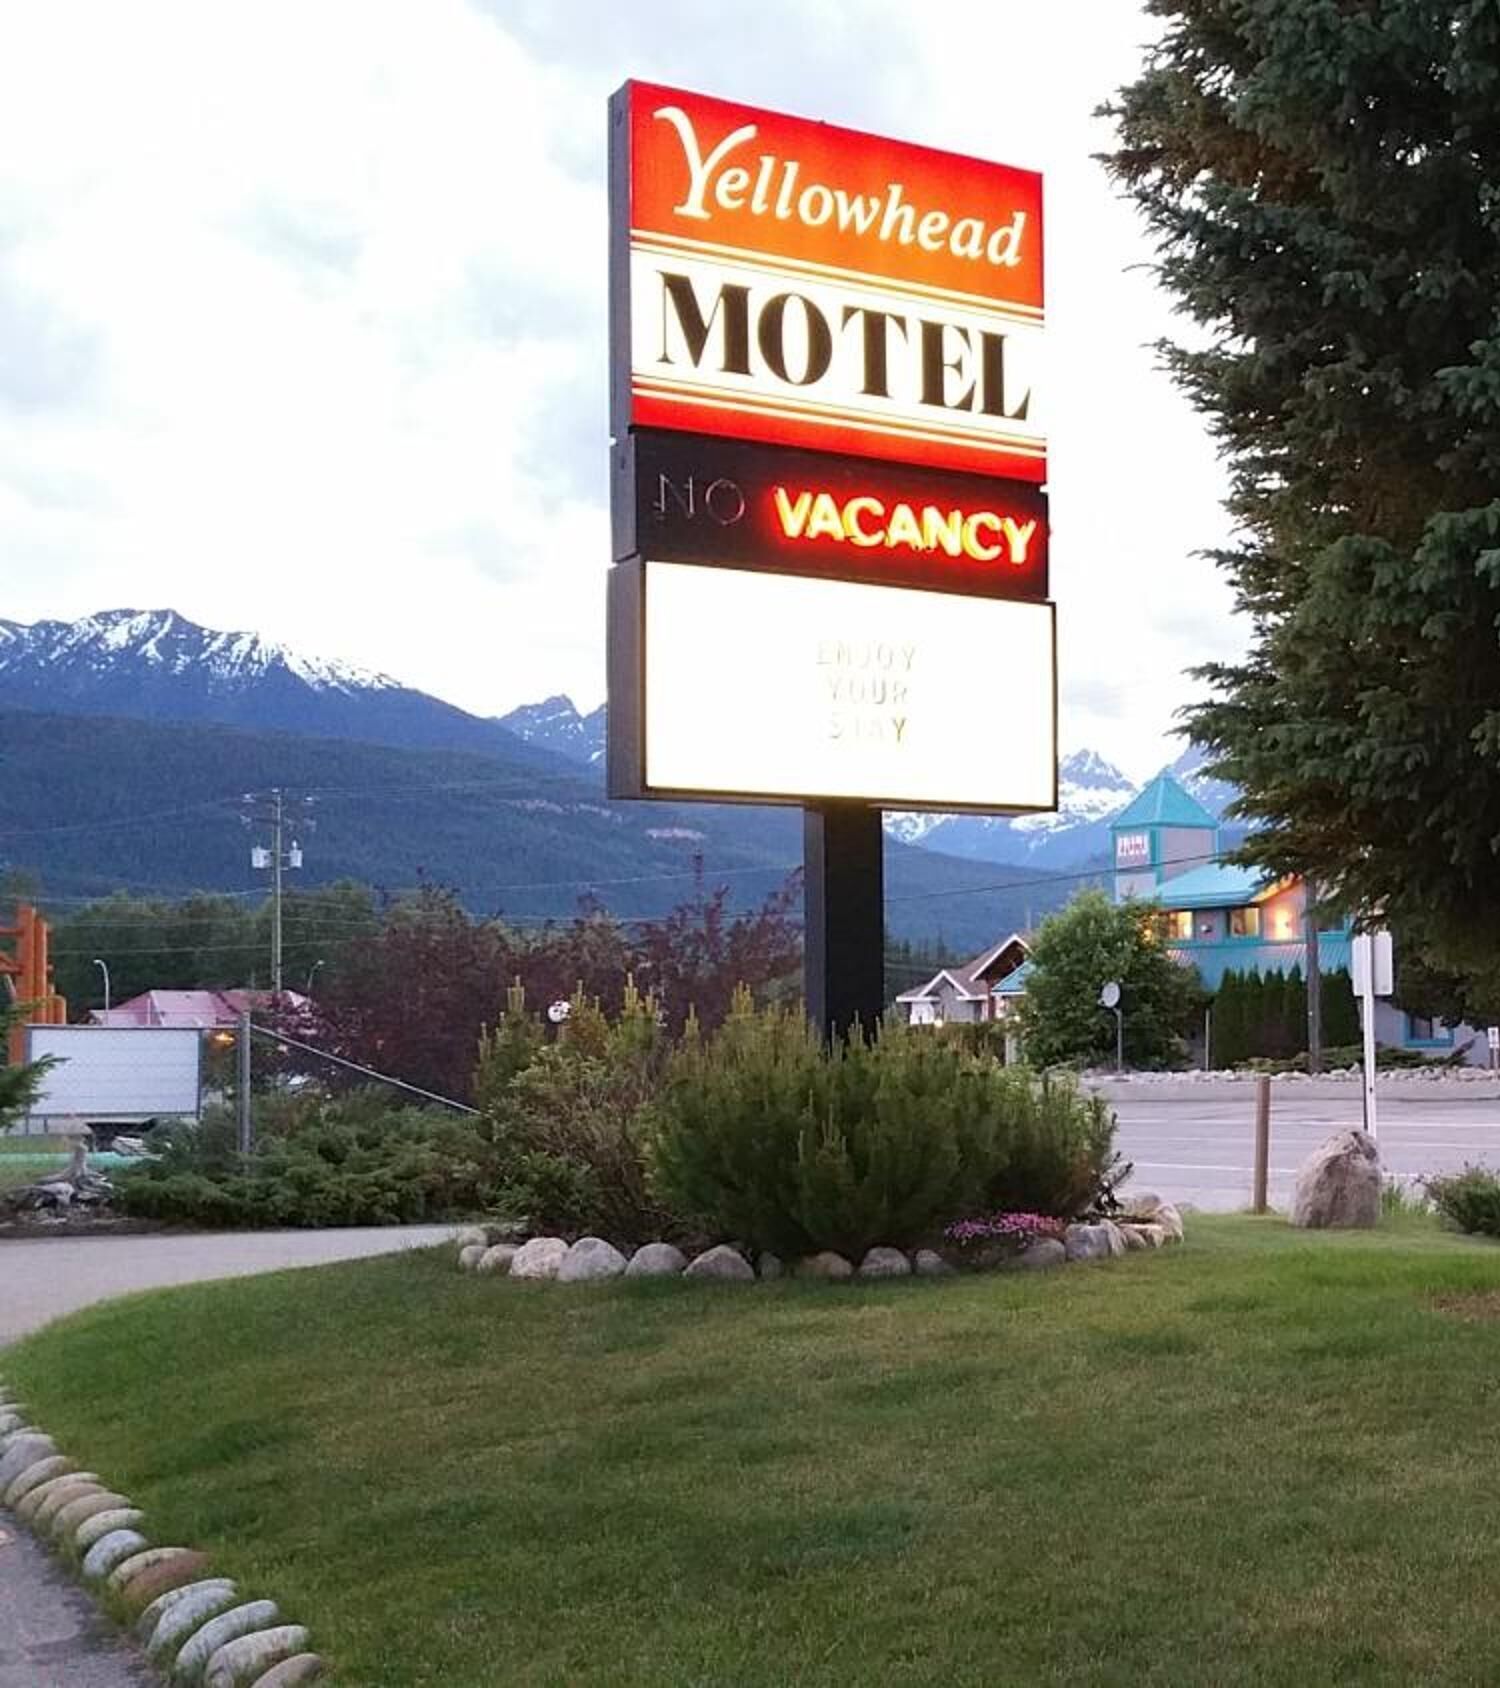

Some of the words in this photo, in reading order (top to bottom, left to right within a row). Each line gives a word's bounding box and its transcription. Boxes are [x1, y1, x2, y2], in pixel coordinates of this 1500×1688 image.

[653, 105, 1026, 267] Yellowhead
[655, 269, 1032, 421] MOTEL
[656, 473, 745, 526] NO
[773, 486, 1037, 565] VACANCY
[816, 640, 917, 671] ENJOY
[826, 678, 908, 705] YOUR
[828, 711, 908, 744] STAY
